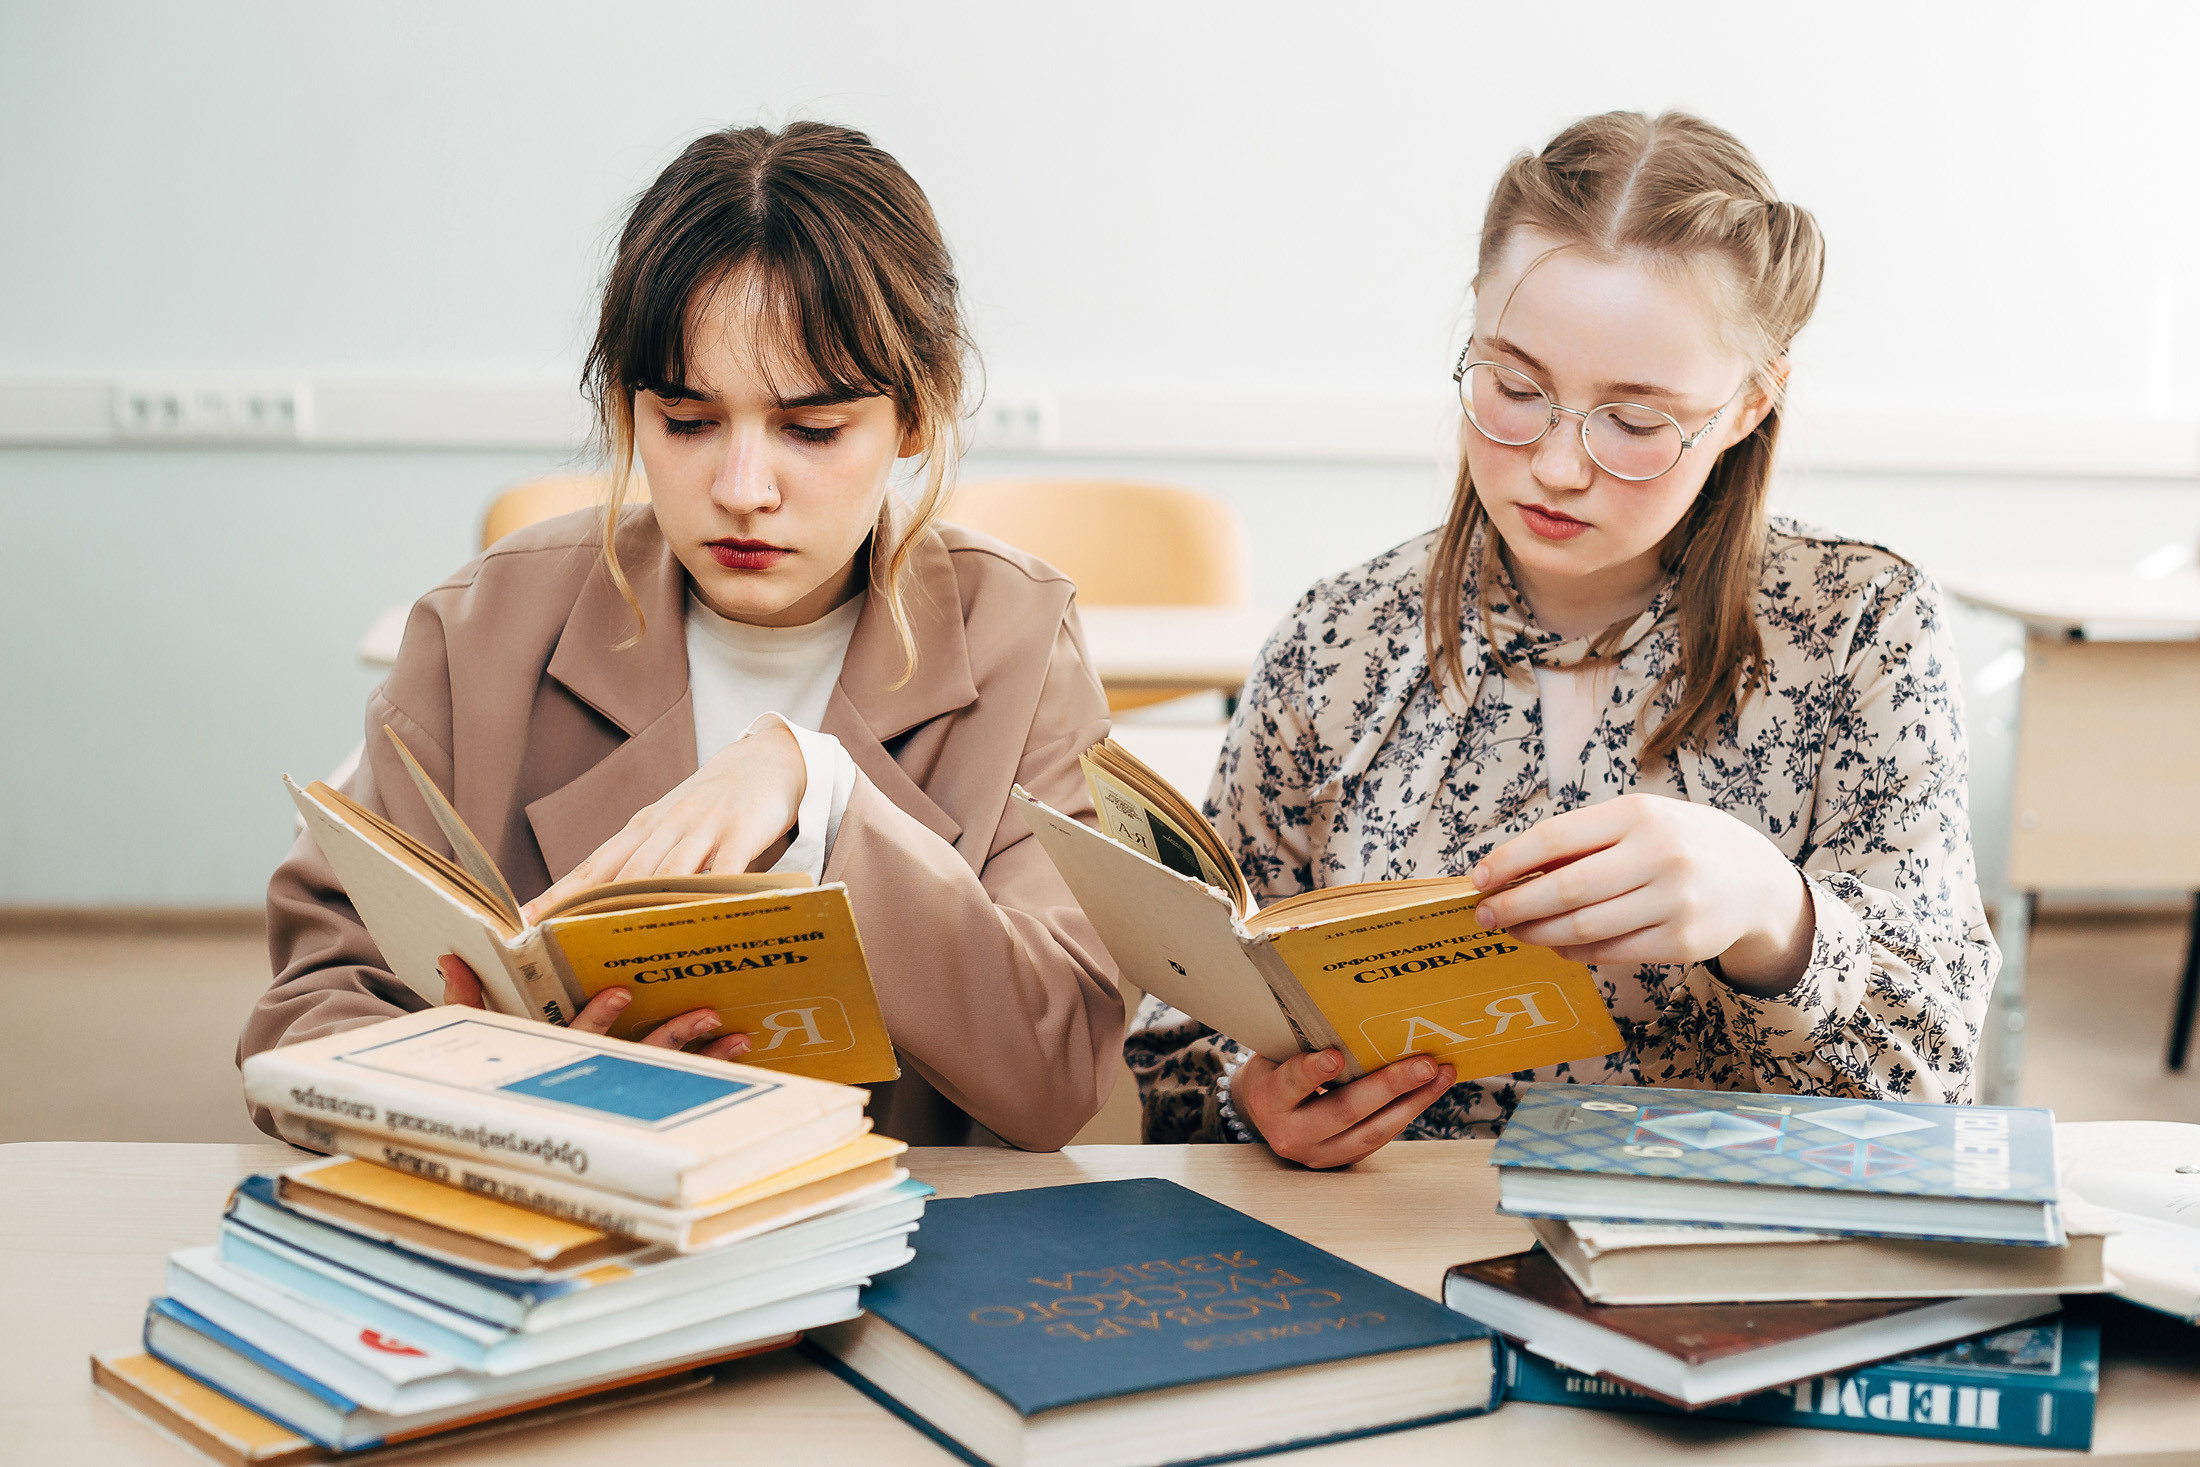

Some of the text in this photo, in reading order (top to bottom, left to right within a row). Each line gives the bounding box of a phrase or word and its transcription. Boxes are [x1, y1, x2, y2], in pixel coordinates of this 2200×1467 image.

[1431, 903, 1477, 918] КРЮЧК
[603, 930, 825, 969] ОРФОГРАФИЧЕСКИЙ
[634, 951, 808, 984] СЛОВАРЬ
[1322, 928, 1508, 972] ОРФОГРАФИЧЕСК
[1353, 941, 1518, 984] СЛОВАРЬ
[1396, 991, 1558, 1056] А-Я
[1581, 1101, 1638, 1113] 8
[1954, 1110, 2009, 1190] ГЕОМЕТРИЯ
[1029, 1250, 1259, 1292] ЯЗЫКА
[969, 1268, 1305, 1327] РУССКОГО
[1046, 1289, 1342, 1342] СЛОВАРЬ
